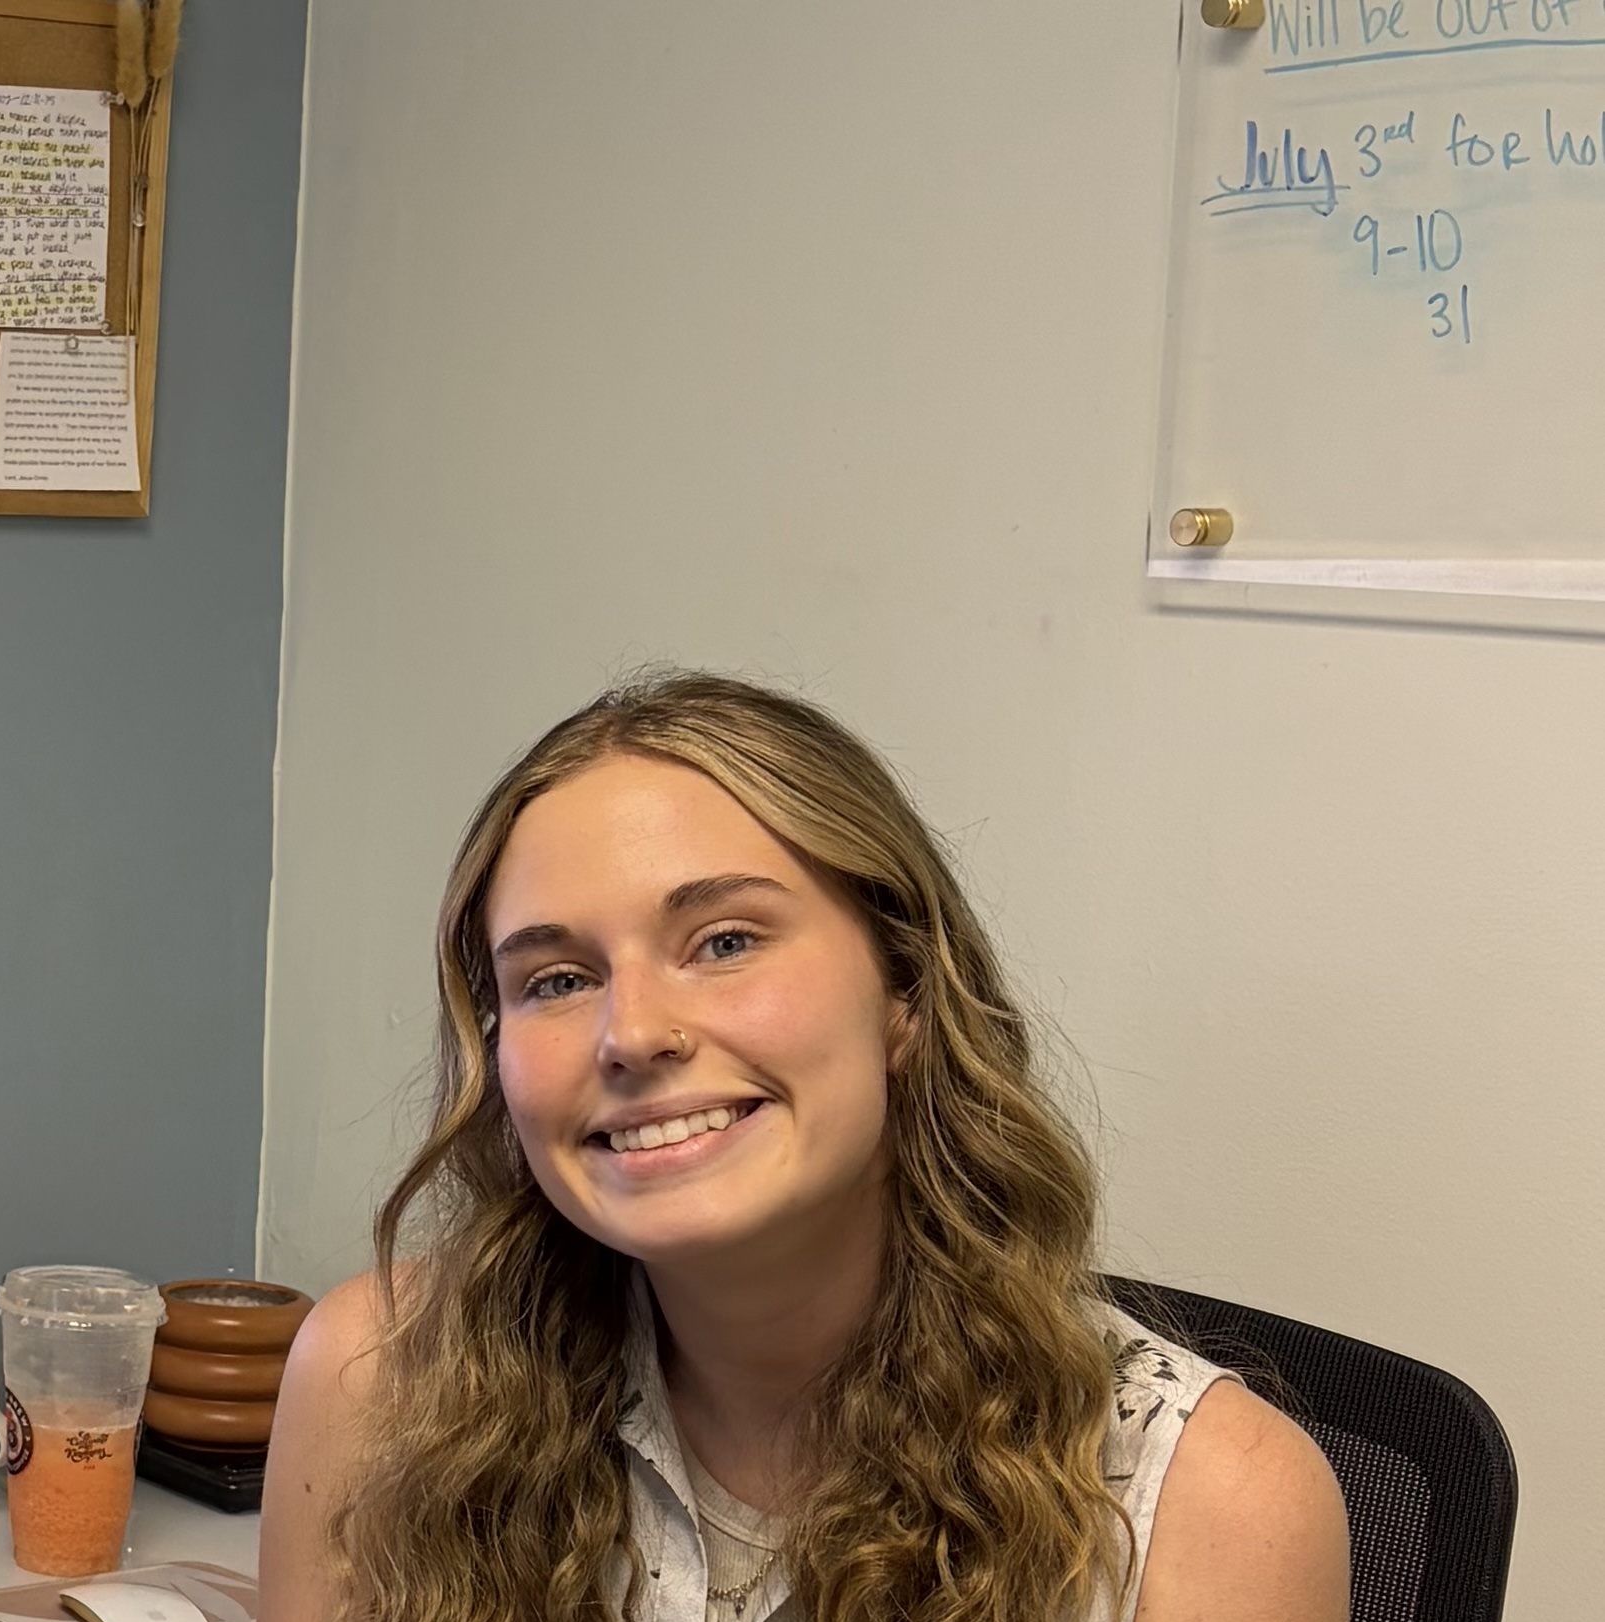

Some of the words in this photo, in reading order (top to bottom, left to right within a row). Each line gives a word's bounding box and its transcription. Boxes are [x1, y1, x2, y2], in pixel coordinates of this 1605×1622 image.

[1270, 0, 1340, 55] Will
[1360, 0, 1409, 44] be
[1218, 120, 1335, 216] July
[1352, 208, 1462, 276] 9-10
[1428, 285, 1471, 344] 31
